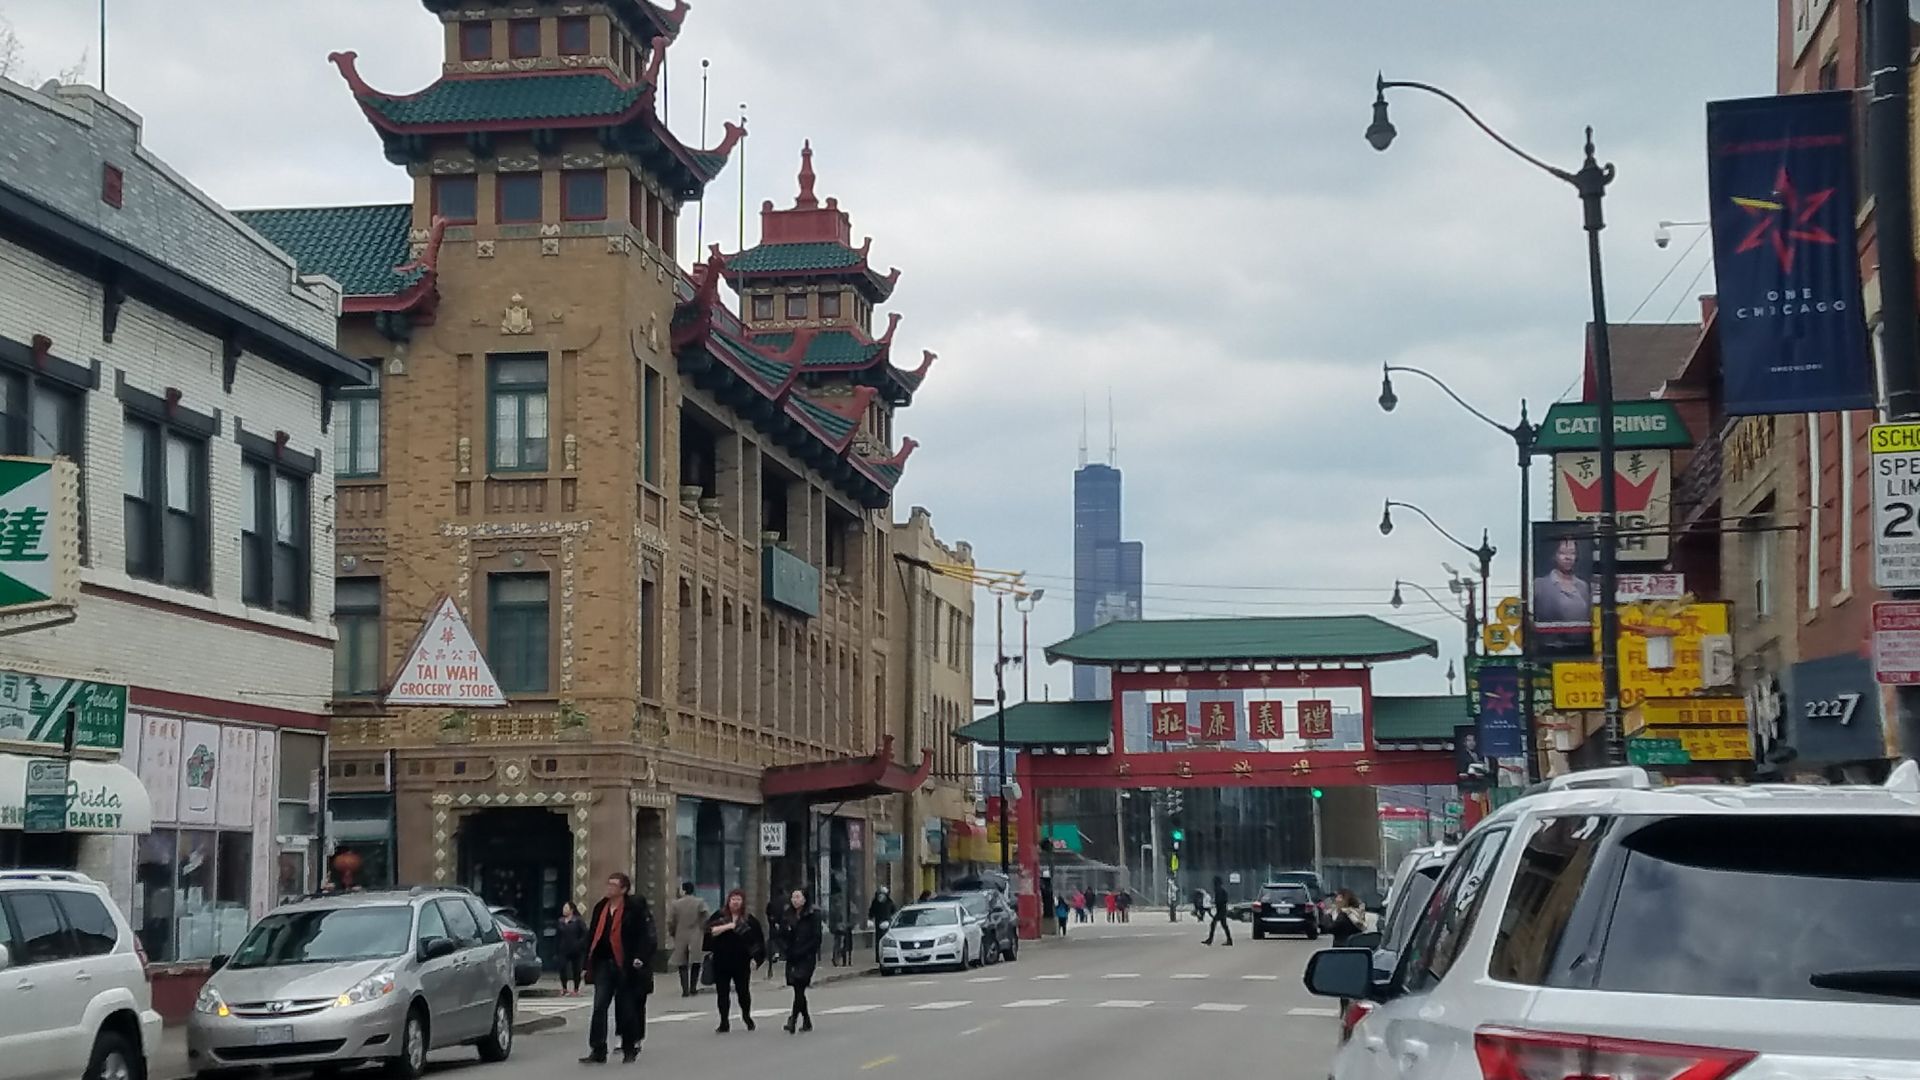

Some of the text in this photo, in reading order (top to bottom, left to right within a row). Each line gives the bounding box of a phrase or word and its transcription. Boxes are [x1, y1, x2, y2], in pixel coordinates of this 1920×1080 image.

[1766, 287, 1812, 302] ONE
[1736, 299, 1847, 319] CHICAGO
[1554, 415, 1668, 434] CATRING
[1883, 501, 1920, 538] 2
[417, 663, 479, 681] TAI WAH
[400, 682, 495, 698] GROCERY STORE
[1805, 692, 1862, 726] 2227
[69, 811, 122, 829] BAKERY
